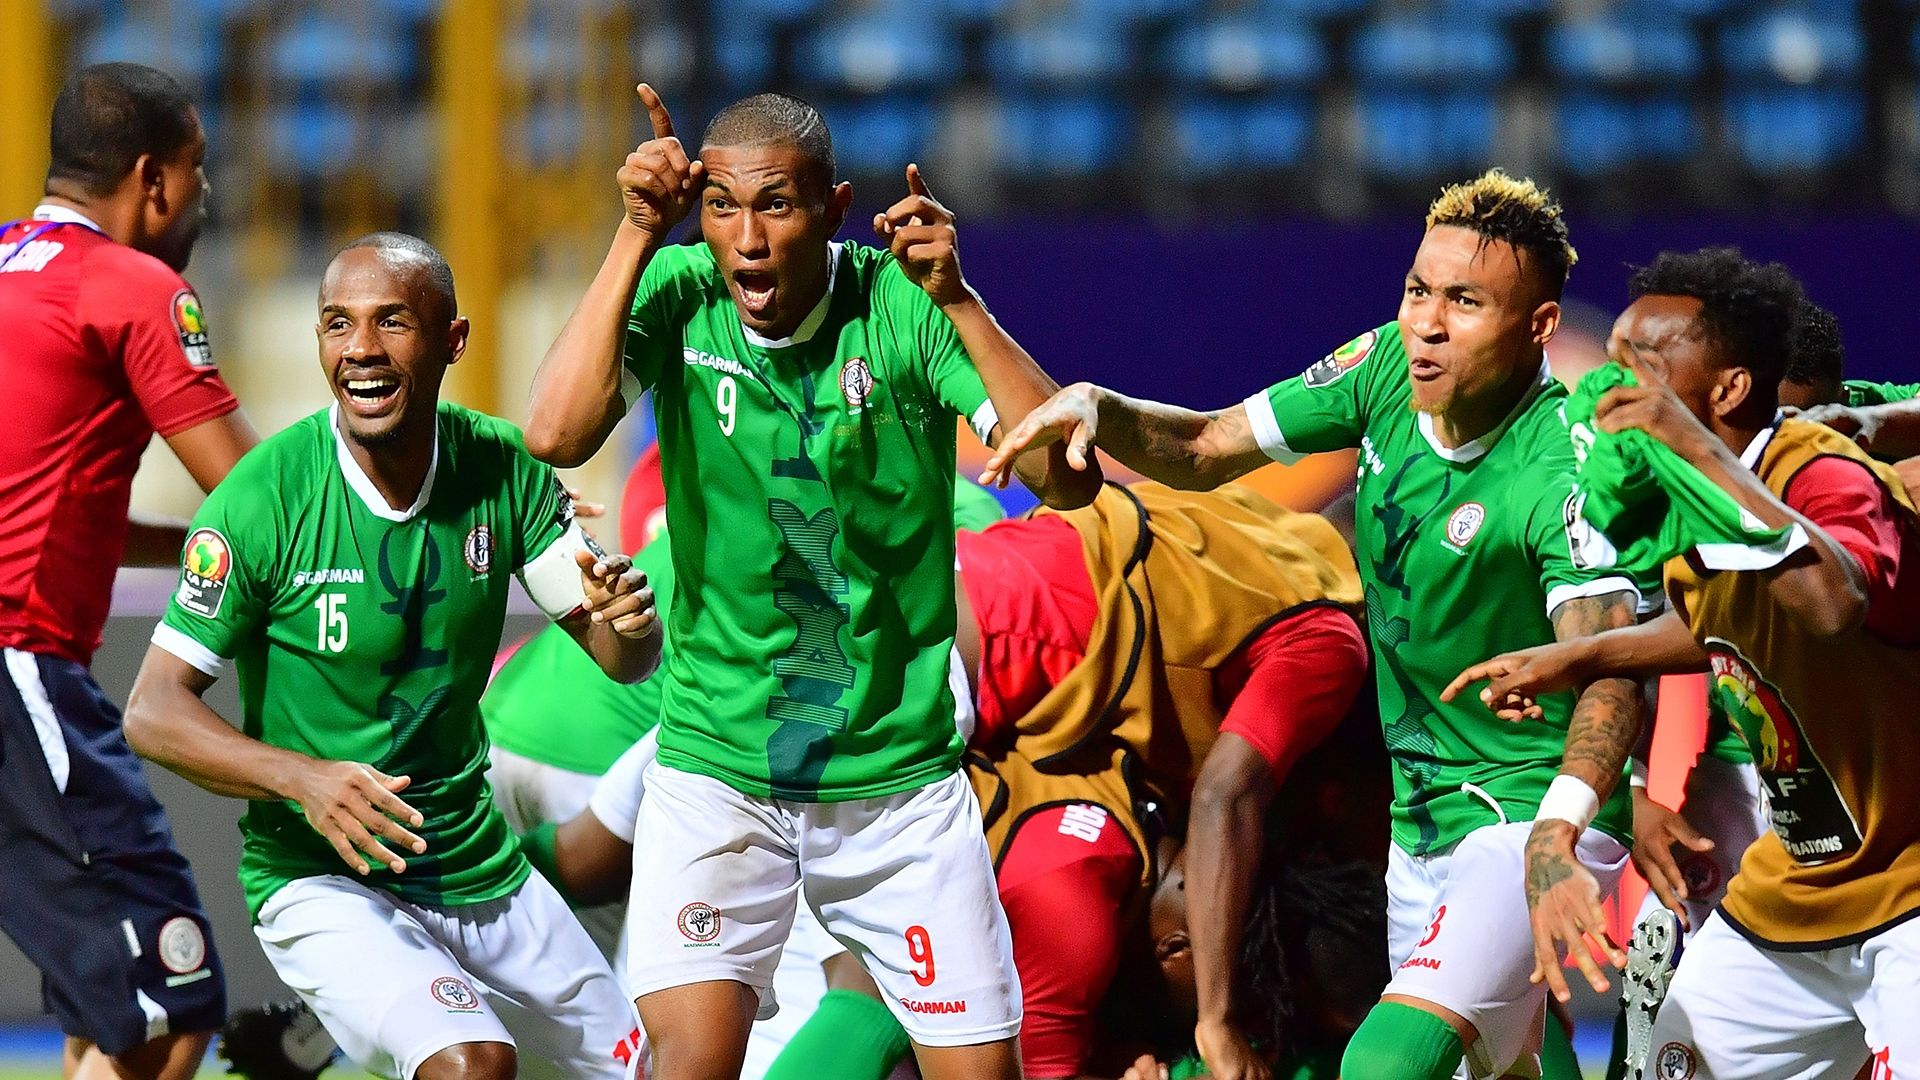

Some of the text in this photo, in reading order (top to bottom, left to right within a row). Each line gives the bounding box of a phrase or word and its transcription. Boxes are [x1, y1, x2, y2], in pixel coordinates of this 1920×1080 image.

[717, 375, 737, 438] 9
[306, 568, 364, 585] GARMAN
[314, 592, 350, 653] 15
[1790, 835, 1843, 856] NATIONS
[905, 925, 936, 987] 9
[911, 1000, 966, 1014] GARMAN
